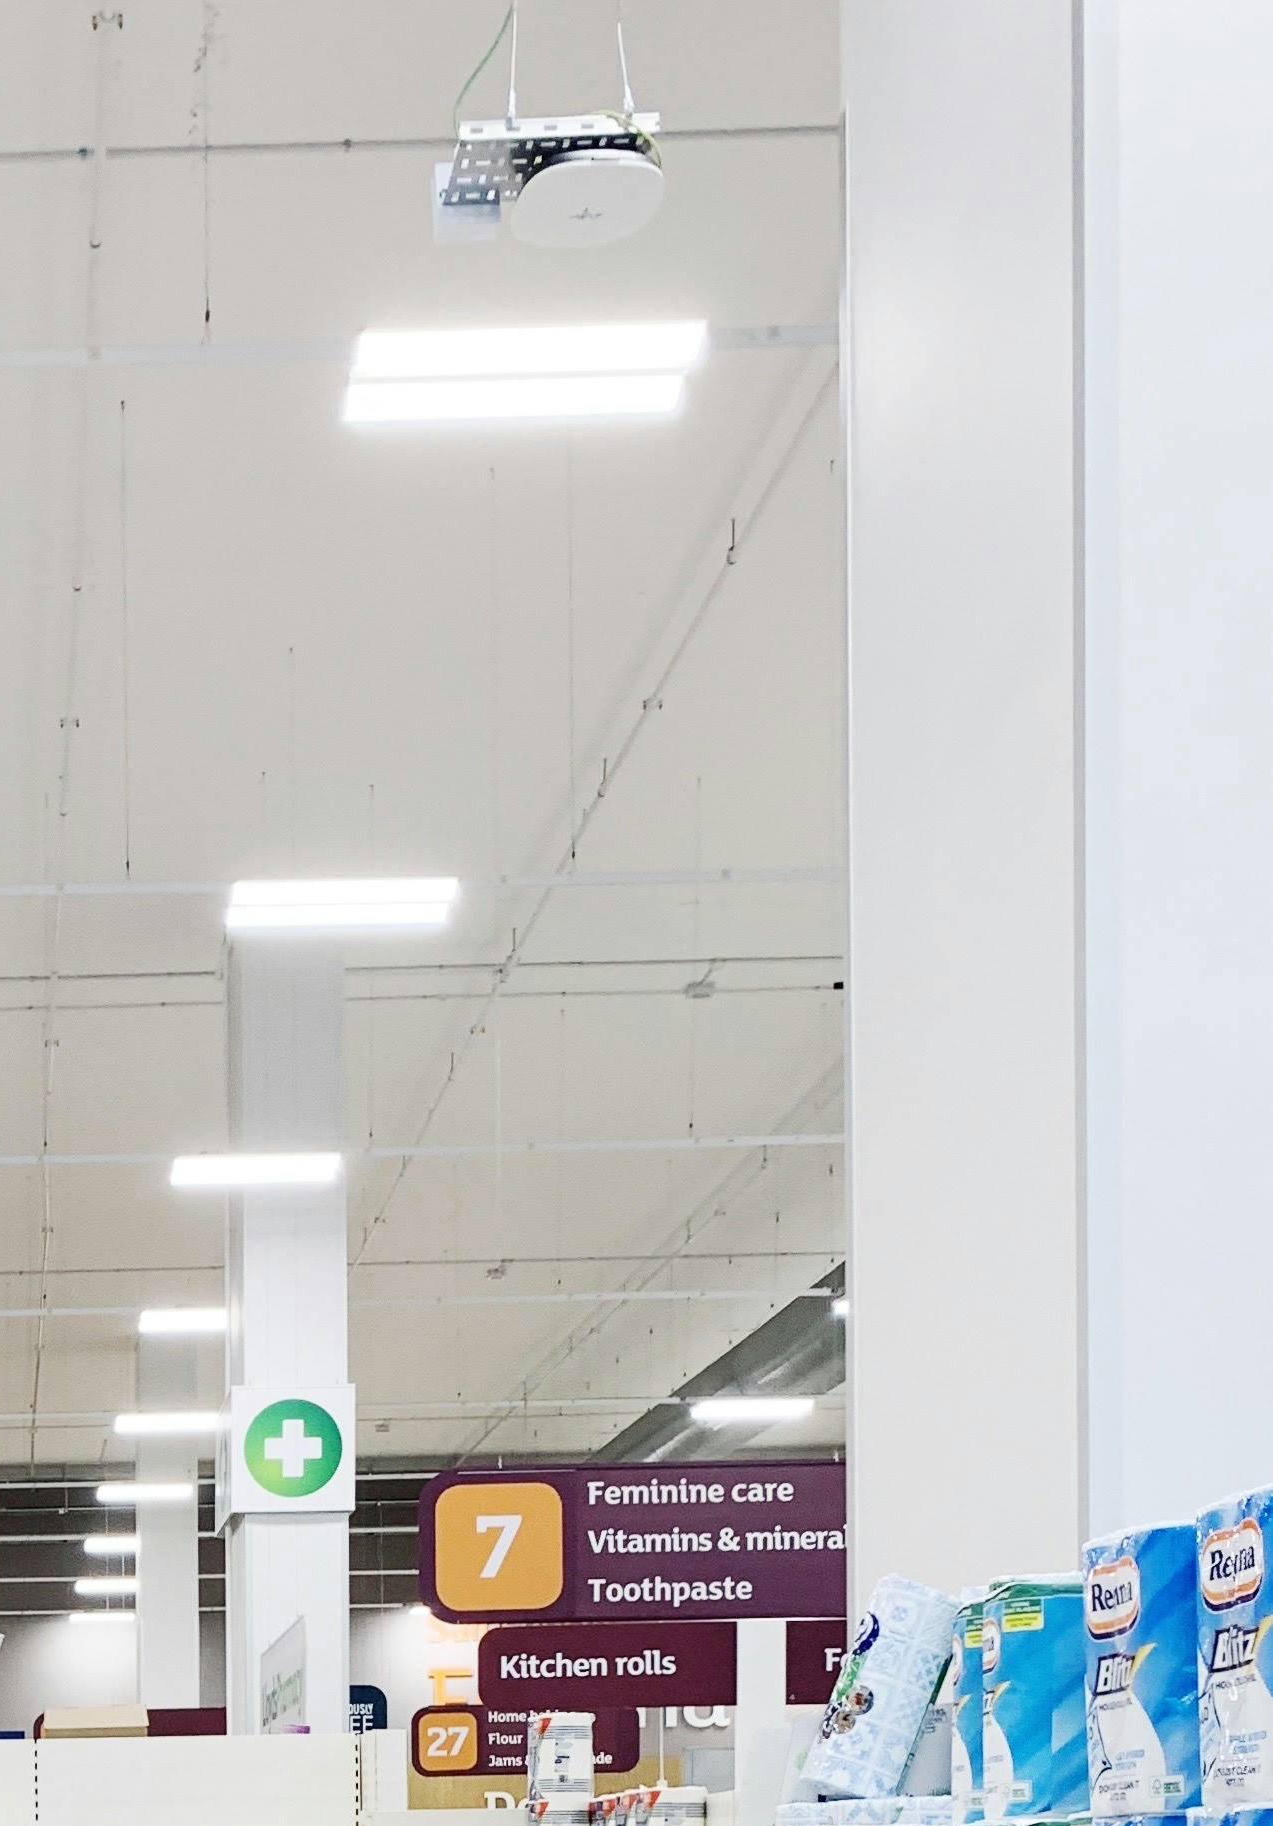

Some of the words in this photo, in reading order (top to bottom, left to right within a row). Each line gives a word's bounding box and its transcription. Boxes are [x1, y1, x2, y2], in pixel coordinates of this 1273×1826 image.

[588, 1478, 725, 1504] Feminine
[731, 1482, 794, 1502] care
[476, 1514, 522, 1579] 7
[588, 1527, 712, 1554] Vitamins
[717, 1527, 741, 1552] &
[745, 1524, 846, 1550] minera
[588, 1576, 752, 1607] Toothpaste
[500, 1653, 607, 1679] Kitchen
[615, 1650, 677, 1675] rolls
[489, 1711, 526, 1723] Home
[427, 1726, 469, 1757] 27
[488, 1733, 523, 1745] Flour
[488, 1755, 522, 1767] Jams
